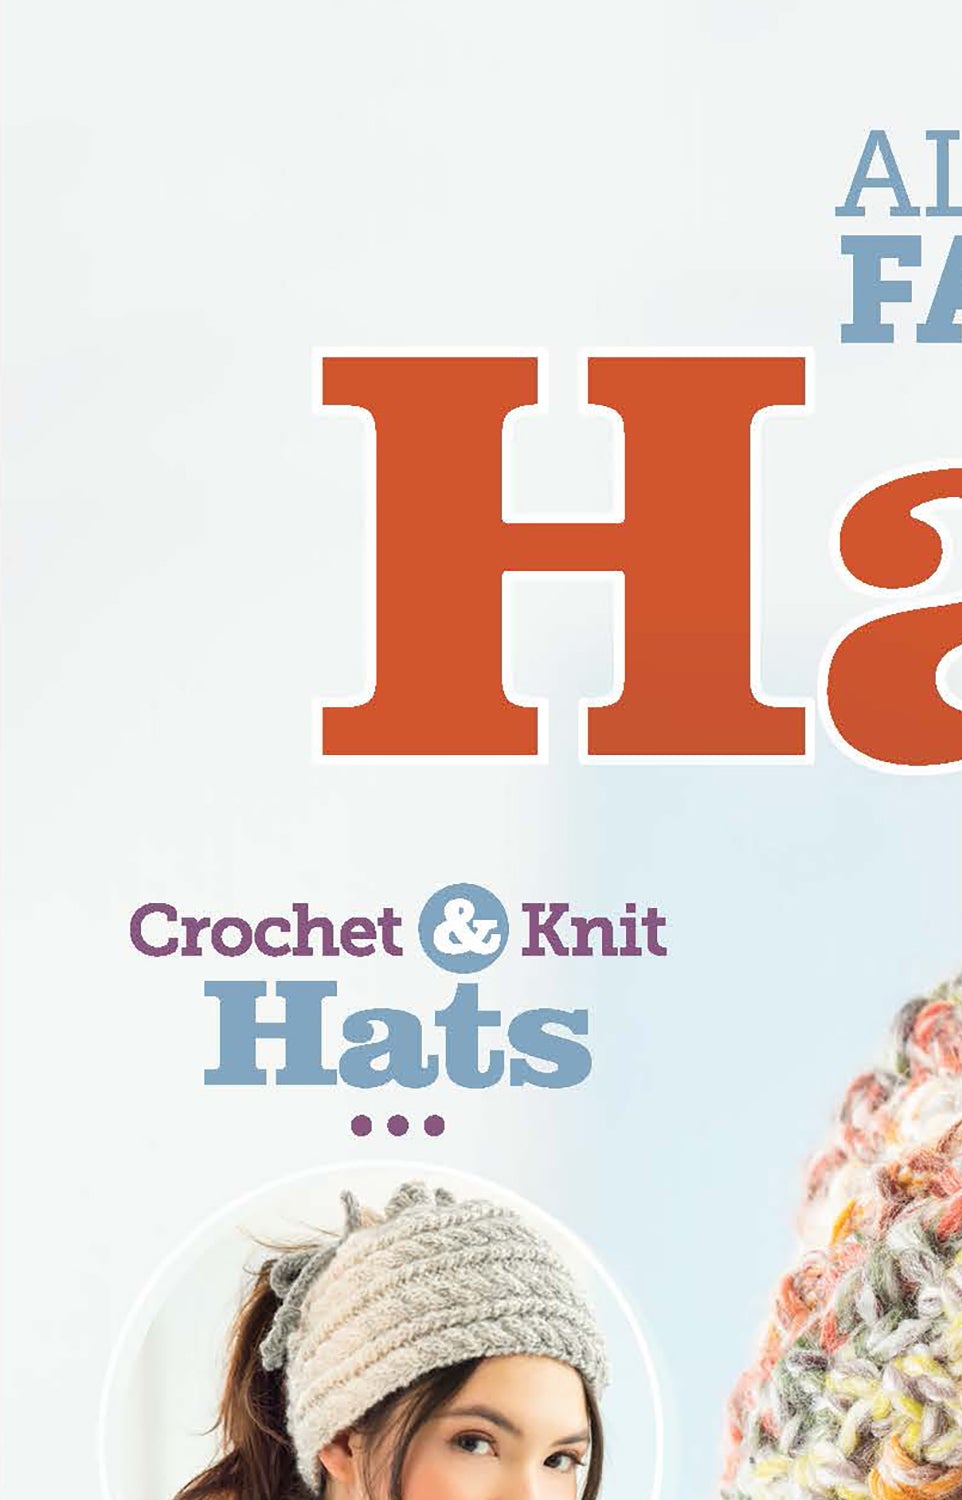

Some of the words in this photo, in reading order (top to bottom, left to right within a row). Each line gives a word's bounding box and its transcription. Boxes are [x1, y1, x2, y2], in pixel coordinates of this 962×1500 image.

[130, 903, 402, 957] Crochet
[432, 897, 502, 956] &
[521, 903, 667, 957] Knit
[204, 980, 593, 1089] Hats
